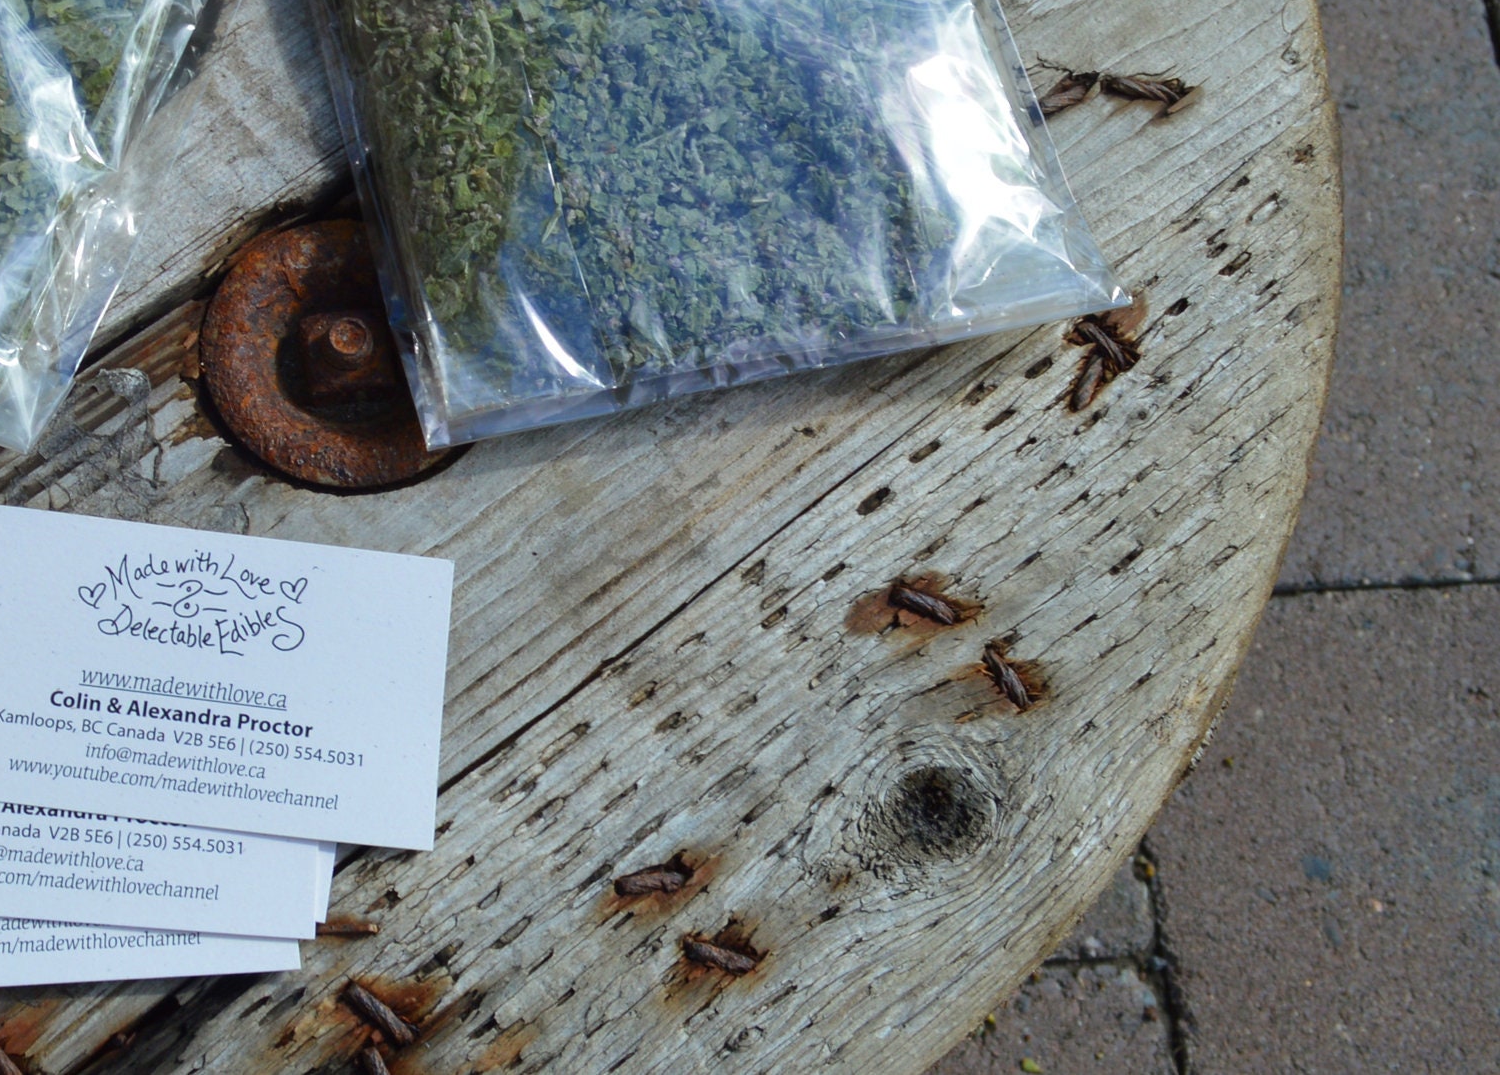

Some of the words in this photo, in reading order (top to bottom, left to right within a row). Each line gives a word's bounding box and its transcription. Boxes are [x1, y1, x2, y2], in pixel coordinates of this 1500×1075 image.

[104, 553, 170, 600] Made
[175, 549, 219, 576] with
[219, 553, 276, 600] Love
[97, 603, 215, 649] Delectable
[79, 669, 288, 710] www.madewithlove.ca
[49, 690, 102, 713] Colin
[106, 696, 123, 715] &
[127, 699, 232, 728] Alexandra
[237, 713, 314, 739] Proctor
[81, 719, 103, 735] BC
[106, 721, 166, 743] Canada
[173, 730, 204, 747] V2B
[207, 734, 237, 752] 5E6
[249, 738, 290, 760] (250)
[293, 745, 365, 768] 554.5031
[85, 742, 266, 780] info@madewithlove.ca
[8, 757, 340, 811] www.youtube.com/madewithlovechannel
[48, 826, 80, 842] V2B
[84, 828, 114, 845] 5E6
[126, 831, 168, 851] (250)
[172, 835, 245, 856] 554.5031
